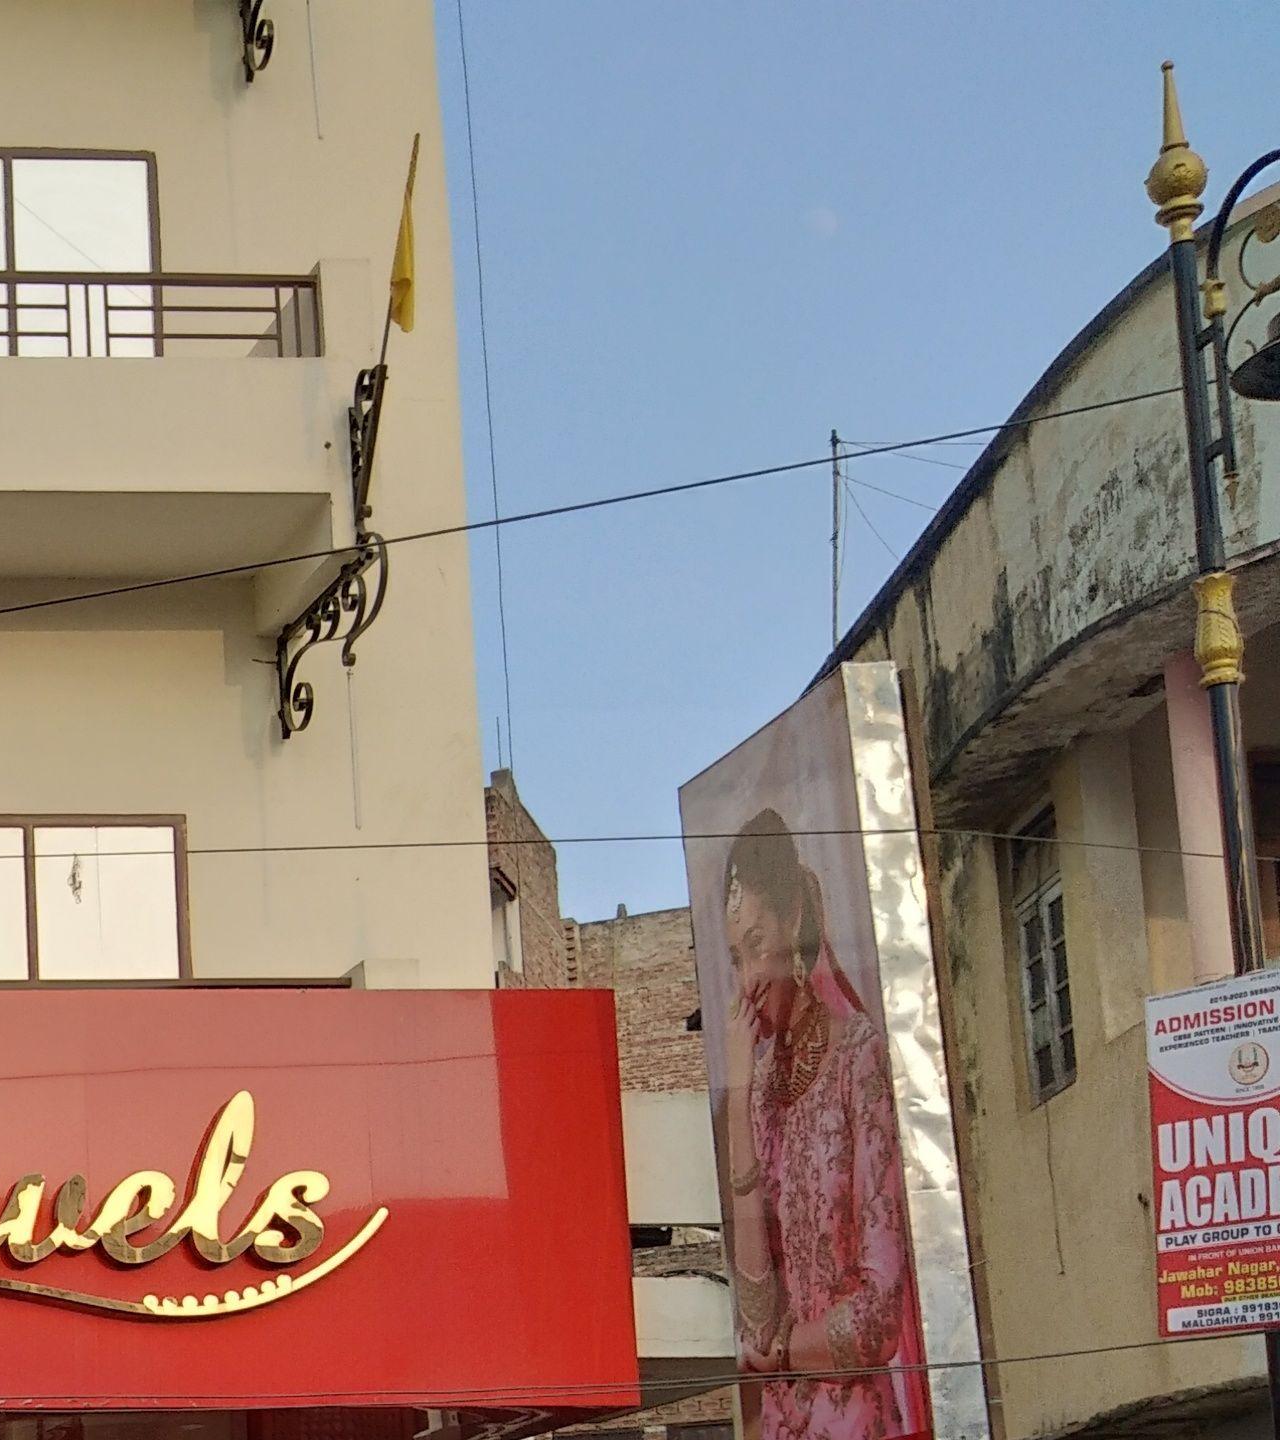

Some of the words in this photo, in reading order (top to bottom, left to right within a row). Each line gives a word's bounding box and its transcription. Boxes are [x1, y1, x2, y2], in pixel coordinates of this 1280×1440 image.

[1154, 999, 1275, 1035] ADMISSION
[1212, 1030, 1249, 1042] TEACHERS
[1165, 1234, 1197, 1248] PLAY
[1202, 1228, 1249, 1243] GROUP
[1254, 1225, 1271, 1236] TO
[1226, 1249, 1236, 1257] OF
[1159, 1266, 1222, 1283] Jawahar
[1181, 1283, 1218, 1299] Mob:
[1224, 1276, 1280, 1293] 98385
[1197, 1307, 1230, 1318] SIGRA
